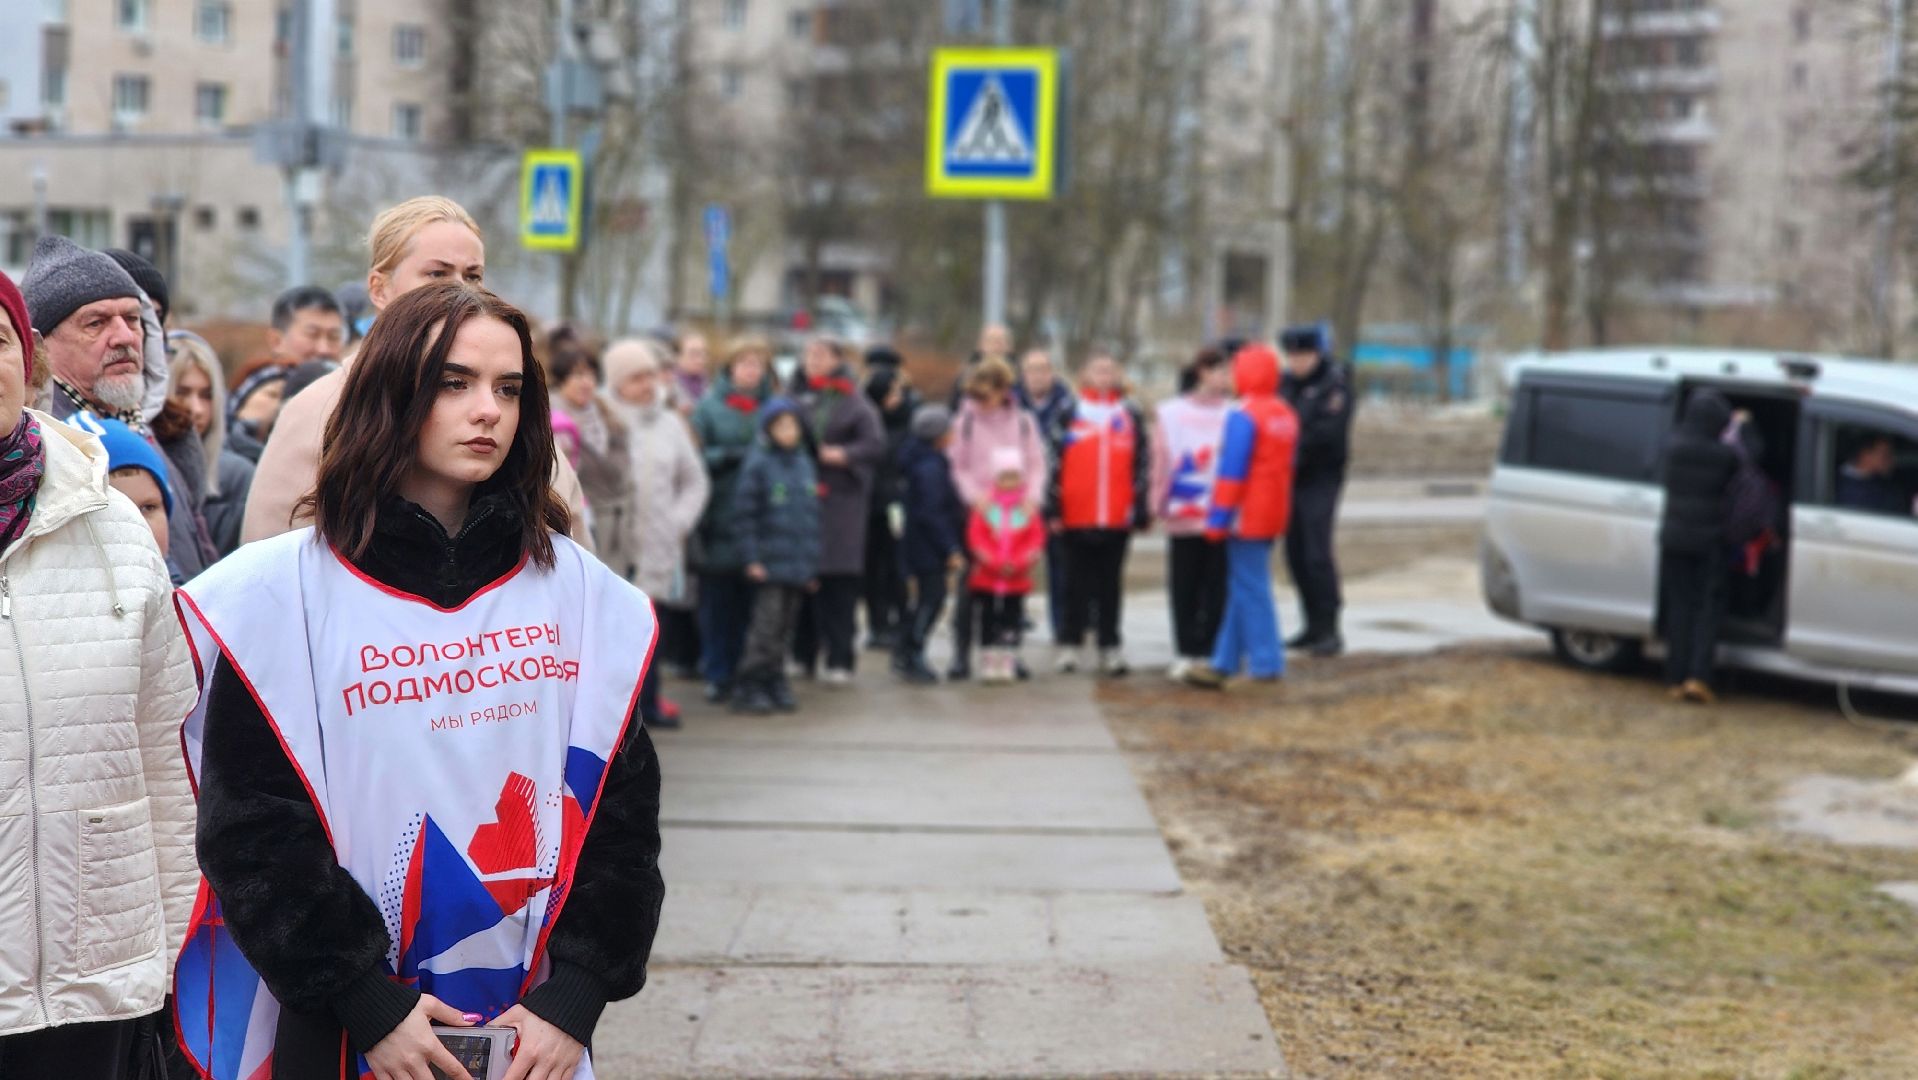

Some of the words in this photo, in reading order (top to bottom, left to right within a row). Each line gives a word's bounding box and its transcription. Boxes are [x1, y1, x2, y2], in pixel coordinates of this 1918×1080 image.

[360, 623, 560, 672] ВОЛОНТЕРЫ
[431, 714, 463, 731] МЫ
[471, 700, 537, 725] РЯДОМ
